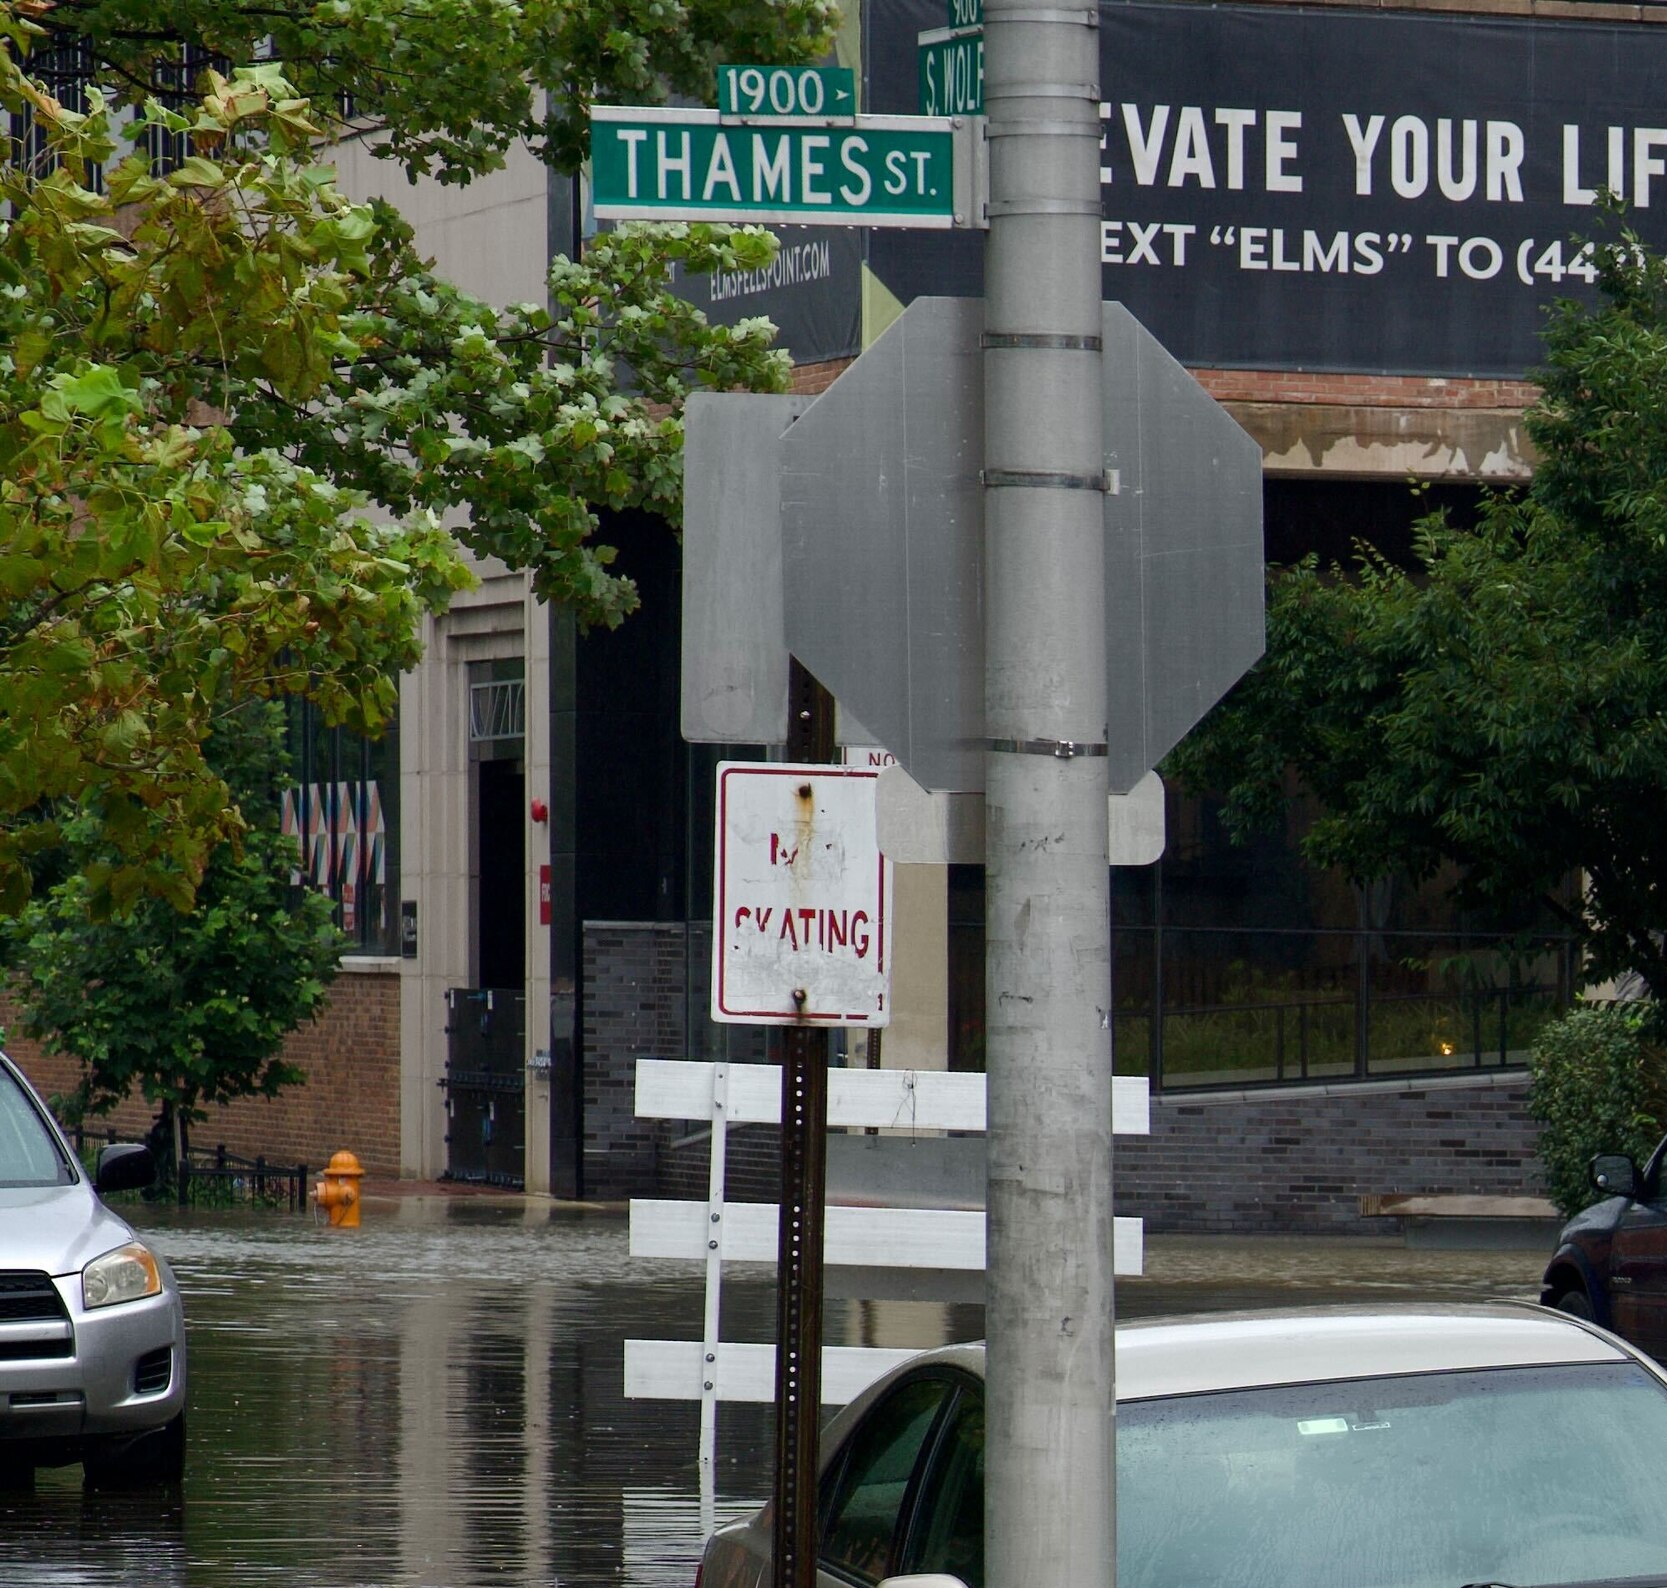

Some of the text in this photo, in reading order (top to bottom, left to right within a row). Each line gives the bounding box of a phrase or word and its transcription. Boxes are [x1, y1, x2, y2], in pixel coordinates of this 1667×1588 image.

[726, 68, 825, 114] 1900
[616, 129, 937, 206] THAMES ST.
[1342, 112, 1526, 203] YOUR
[1426, 235, 1503, 281] TO
